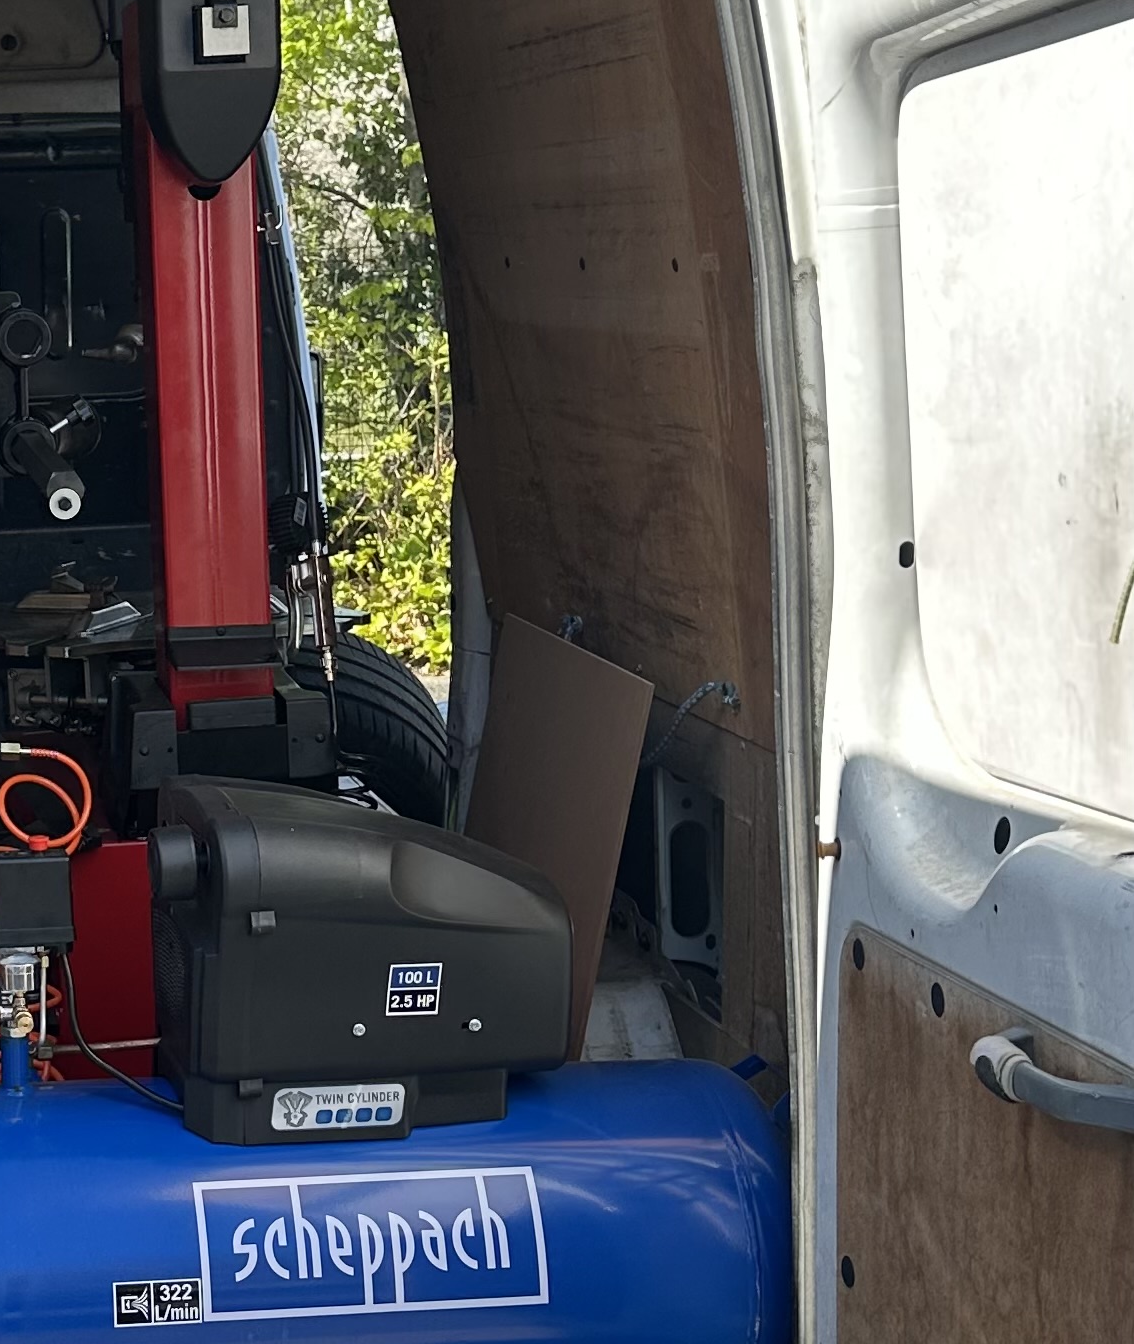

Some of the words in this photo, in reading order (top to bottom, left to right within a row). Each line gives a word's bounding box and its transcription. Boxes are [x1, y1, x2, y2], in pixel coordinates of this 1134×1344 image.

[397, 971, 423, 984] 100
[426, 971, 434, 983] L
[390, 995, 413, 1008] 2.5
[417, 994, 435, 1007] HP
[315, 1093, 344, 1105] TWIN
[347, 1091, 400, 1104] CYLINDER
[233, 1176, 511, 1305] scheppach
[159, 1283, 193, 1302] 322
[154, 1302, 199, 1321] L/min
